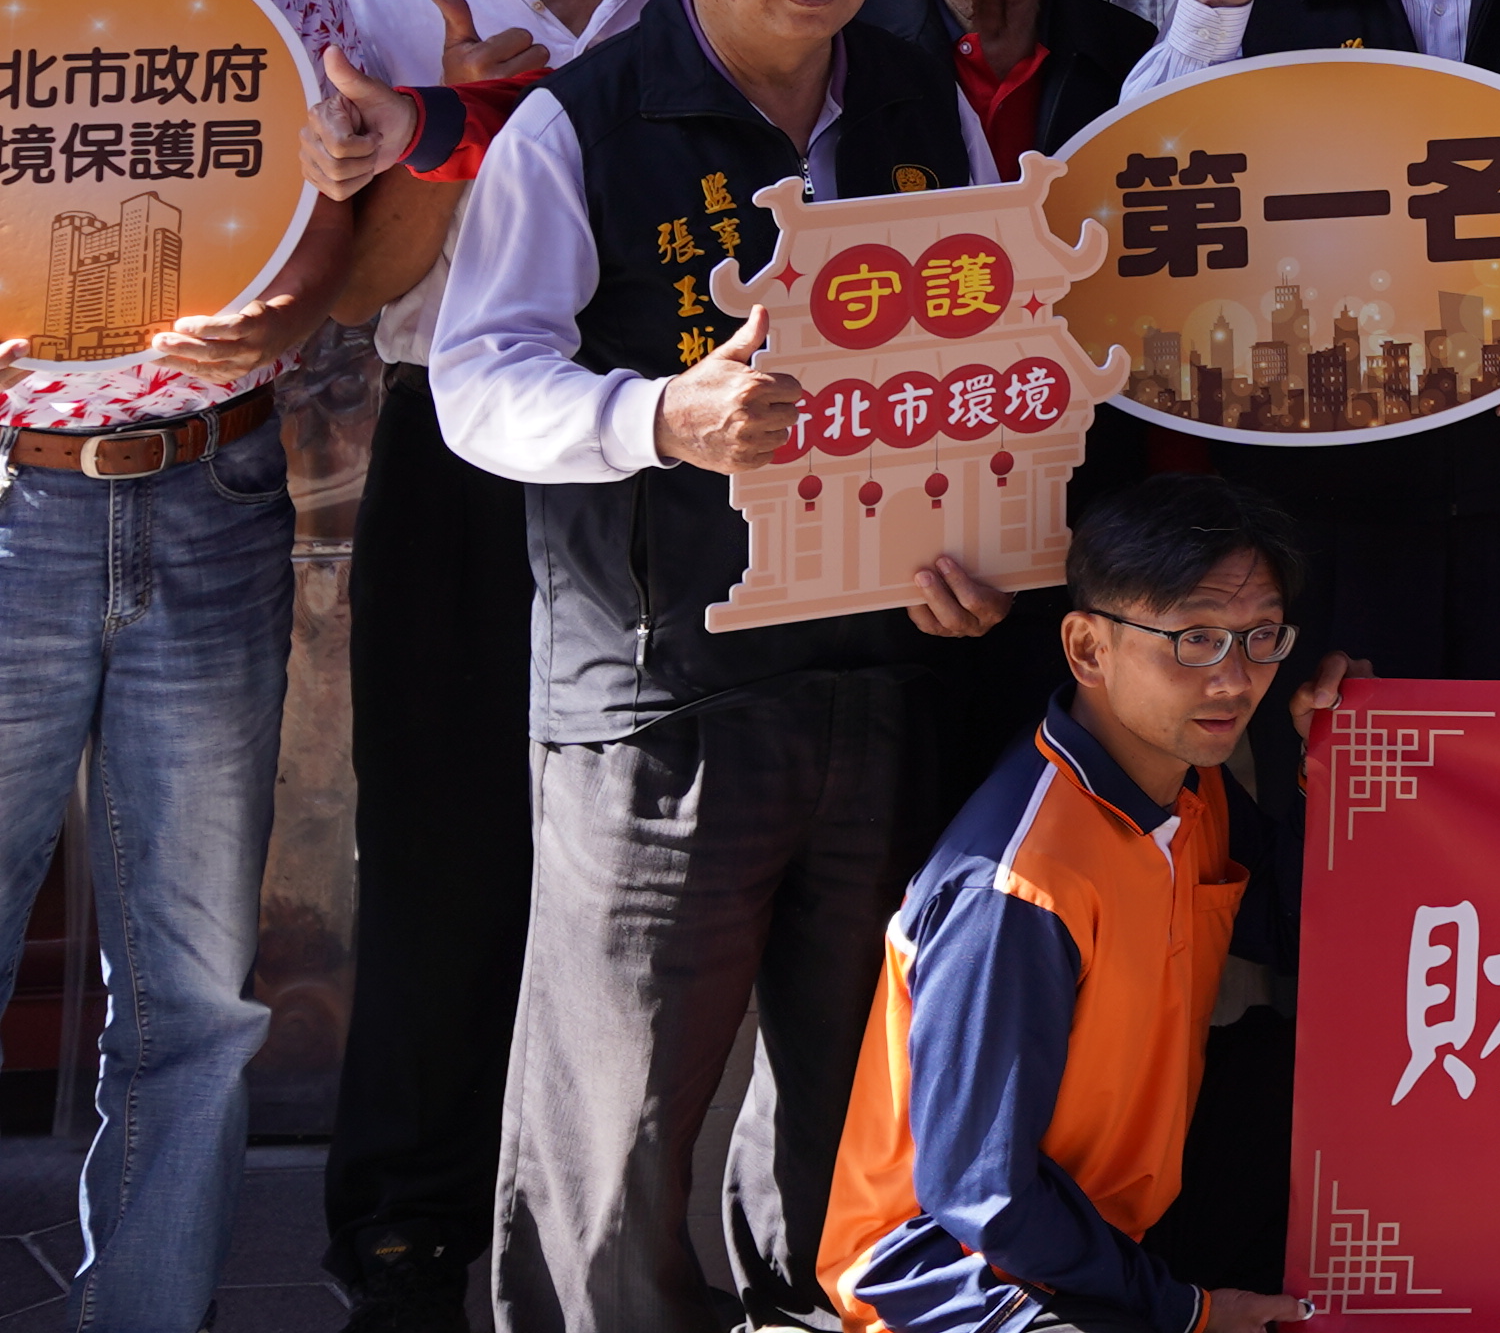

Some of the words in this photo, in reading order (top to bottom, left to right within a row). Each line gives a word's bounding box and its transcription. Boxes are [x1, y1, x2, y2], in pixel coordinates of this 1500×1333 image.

[0, 43, 268, 110] 北市政府
[700, 171, 742, 259] 監事
[827, 249, 1004, 330] 守護
